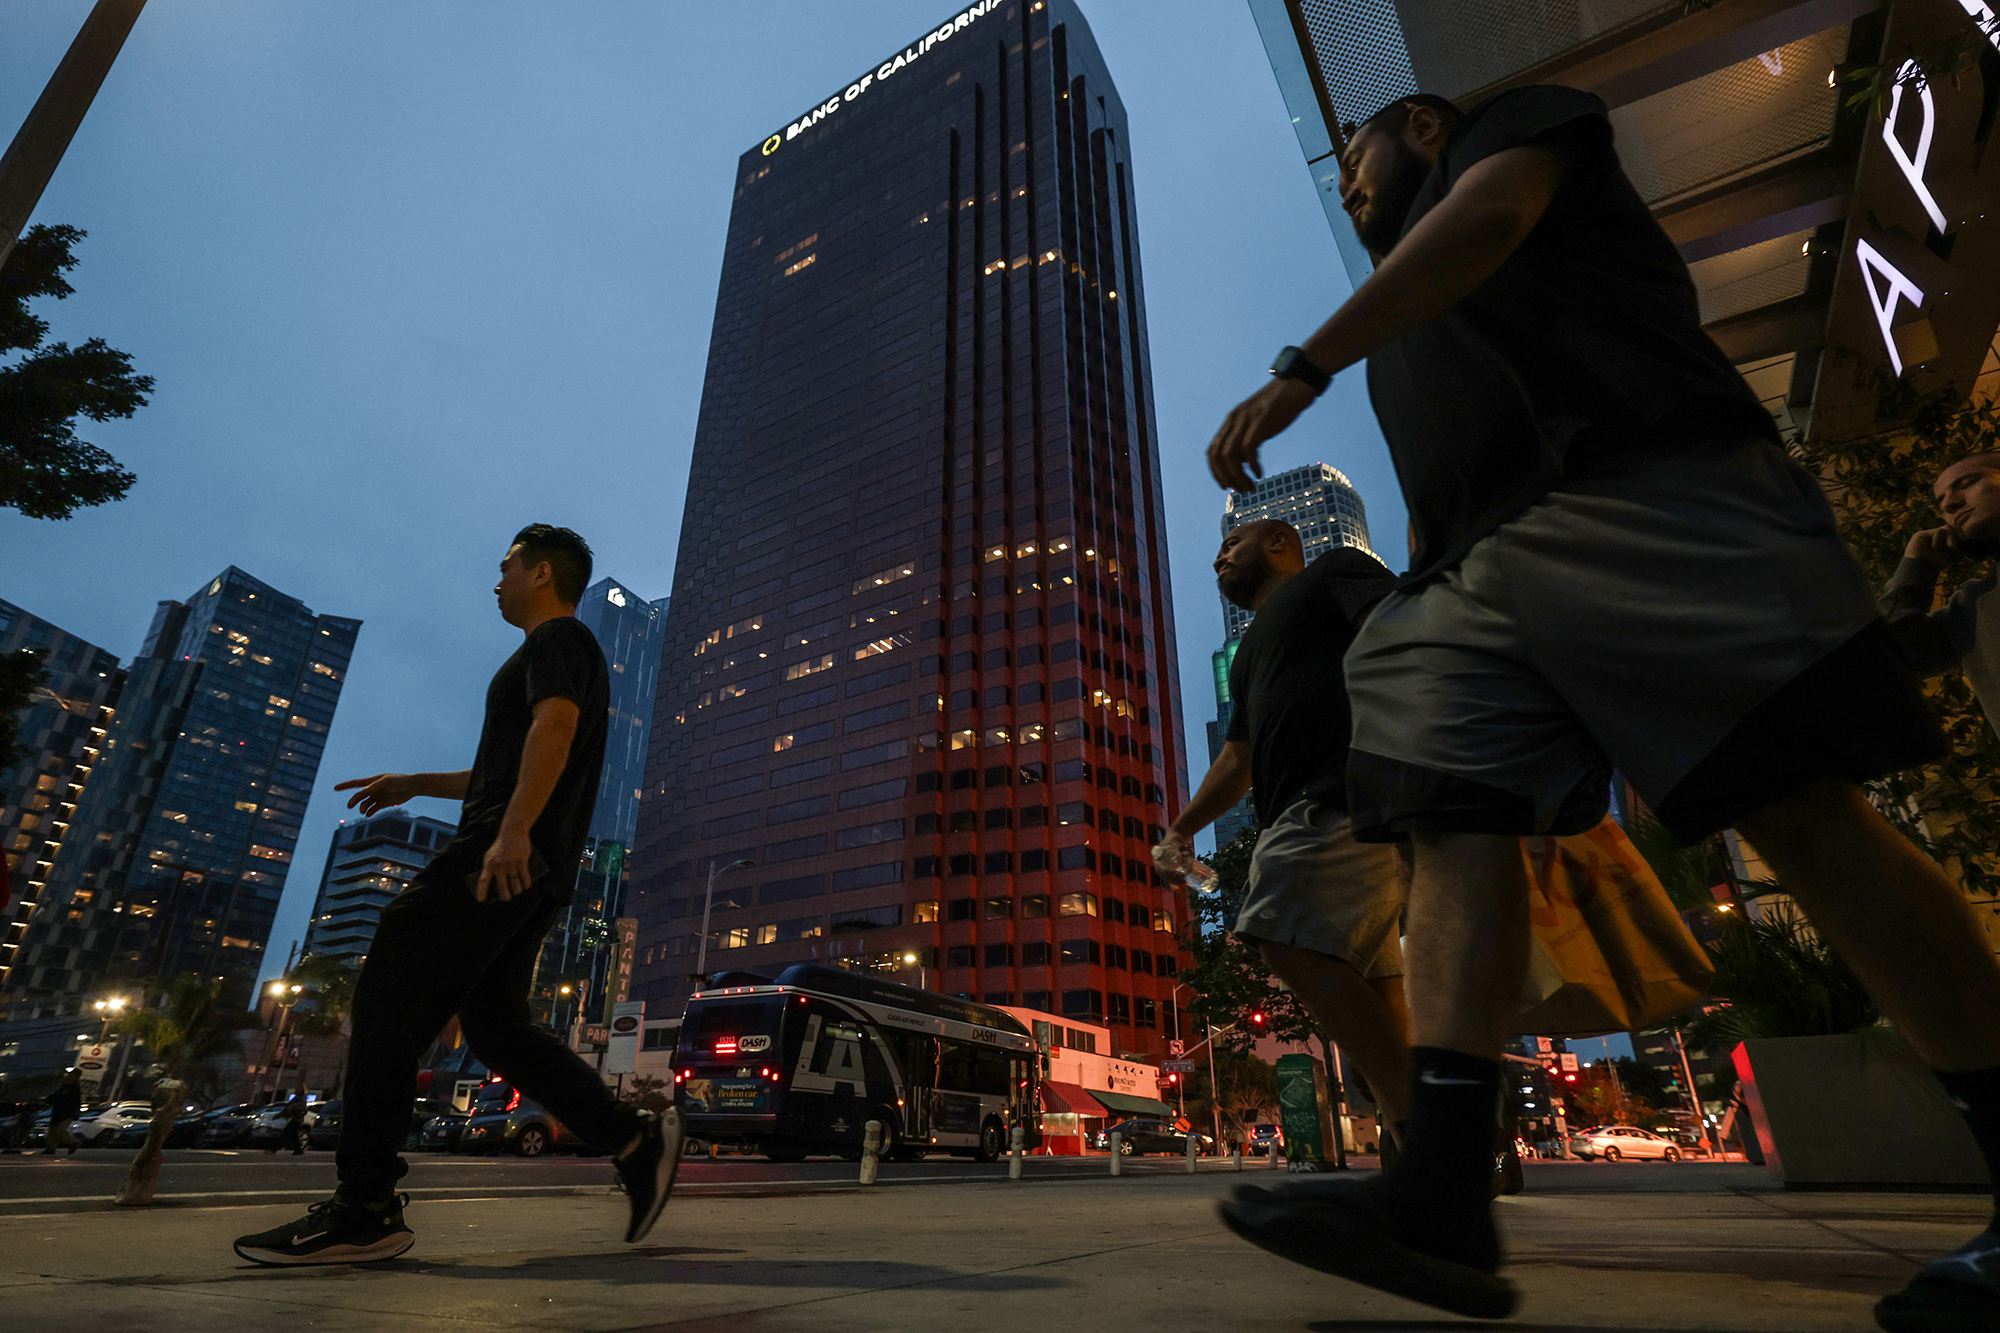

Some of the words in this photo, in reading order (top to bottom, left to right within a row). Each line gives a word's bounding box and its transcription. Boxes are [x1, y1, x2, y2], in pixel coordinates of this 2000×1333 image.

[786, 96, 840, 141] BANC
[844, 73, 873, 102] OF
[887, 1013, 902, 1022] CLEAN
[909, 1017, 925, 1026] VEHICLE
[586, 1027, 611, 1042] PAR
[971, 1028, 997, 1043] DASH
[741, 1038, 767, 1048] DASH
[790, 1013, 867, 1098] LA
[718, 1089, 744, 1098] Broken
